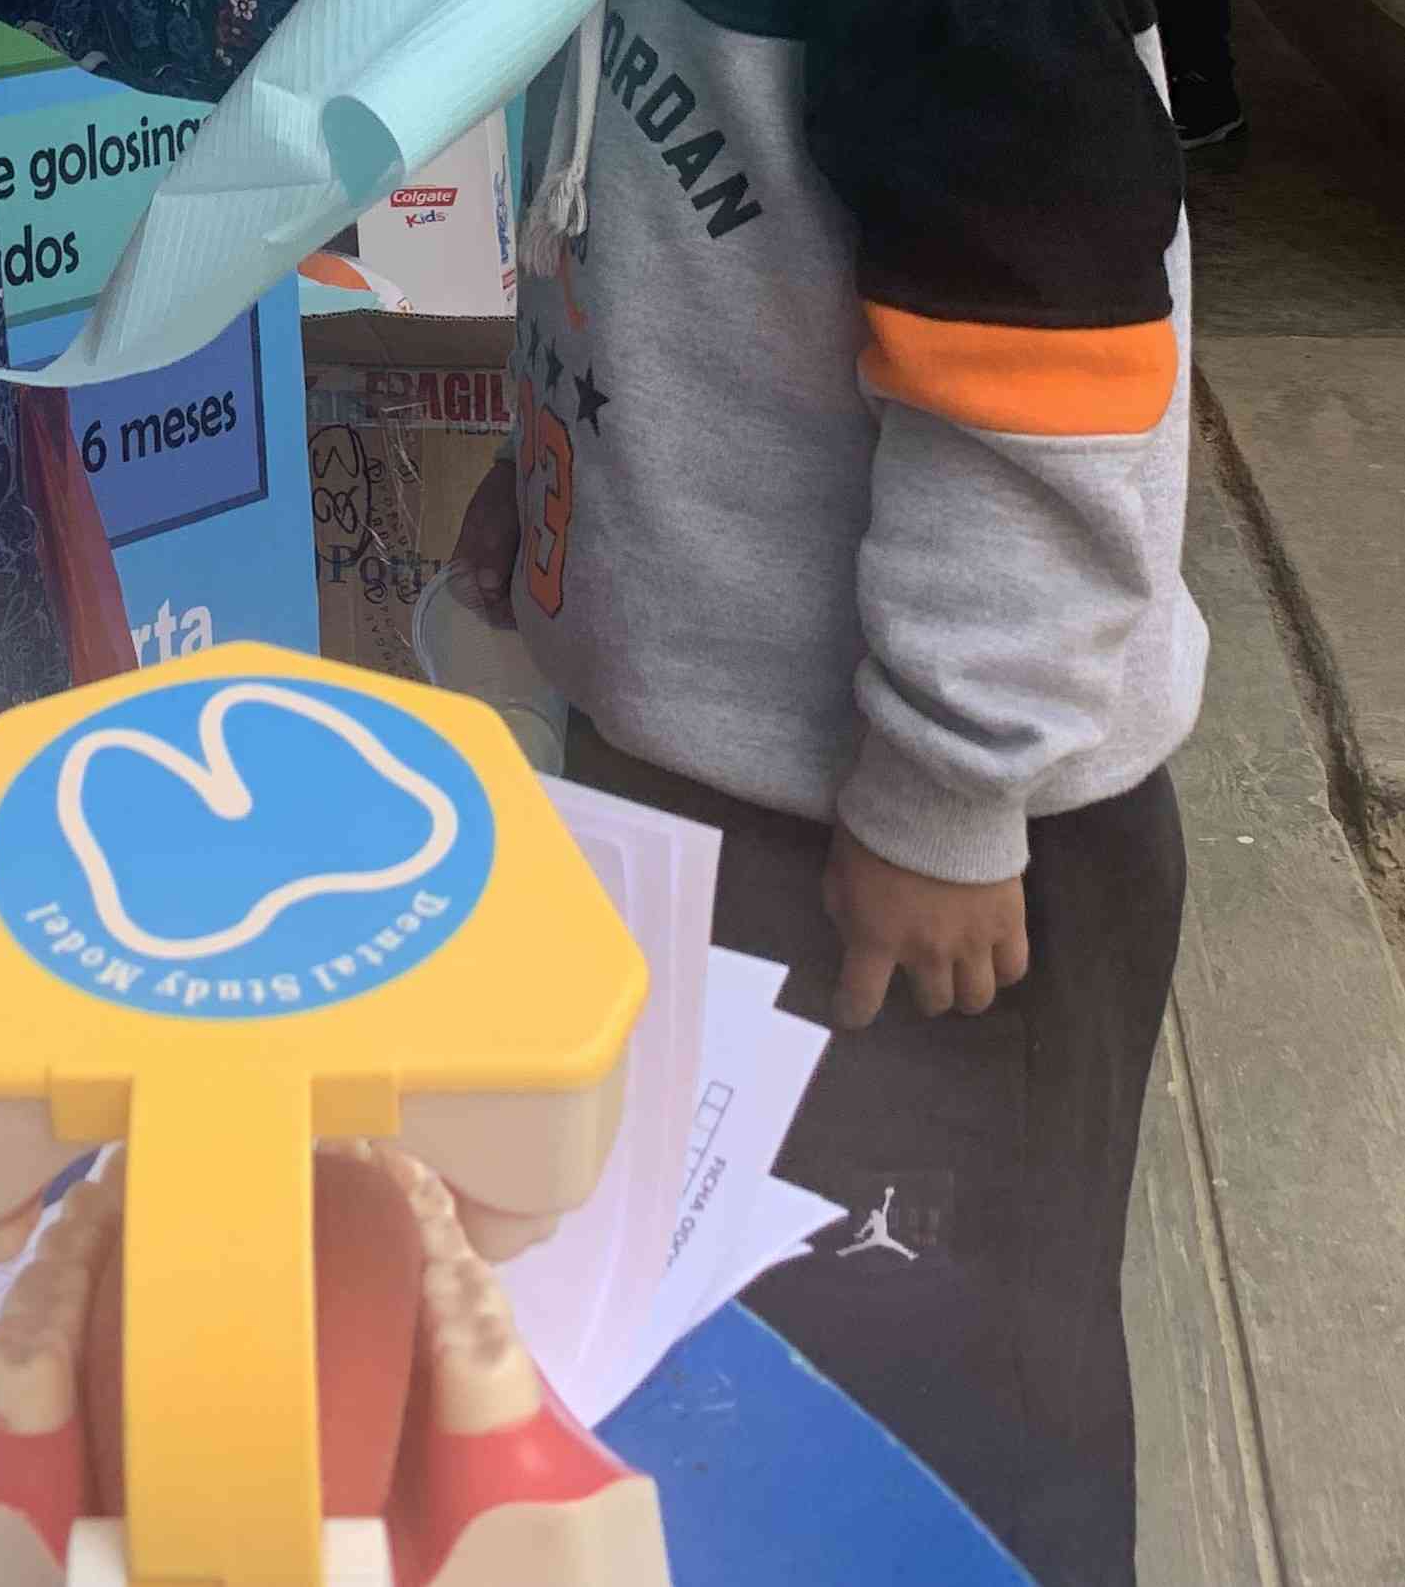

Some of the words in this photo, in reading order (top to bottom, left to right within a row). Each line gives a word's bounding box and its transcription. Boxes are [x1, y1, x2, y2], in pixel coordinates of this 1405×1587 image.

[600, 12, 763, 240] ORDAN
[392, 189, 454, 206] Colgate
[0, 224, 80, 287] dos
[120, 389, 238, 464] meses
[130, 597, 213, 670] rta
[23, 900, 145, 995] Model
[311, 889, 452, 992] Dental
[154, 969, 302, 1008] Study
